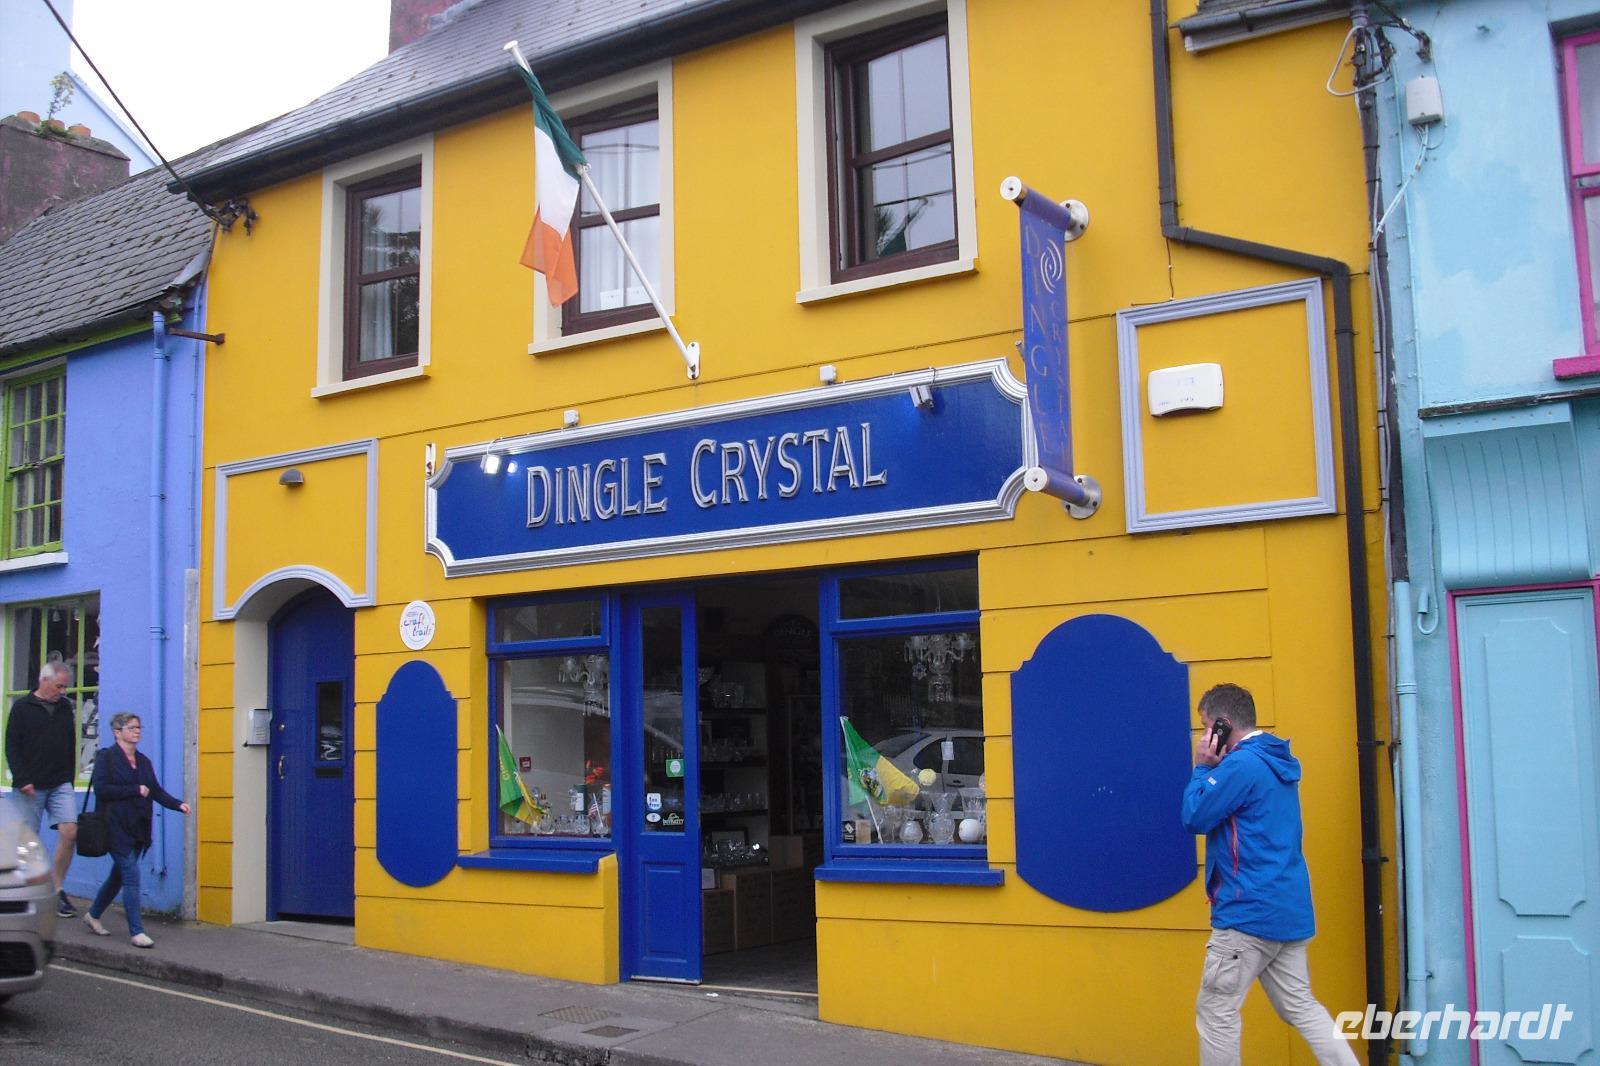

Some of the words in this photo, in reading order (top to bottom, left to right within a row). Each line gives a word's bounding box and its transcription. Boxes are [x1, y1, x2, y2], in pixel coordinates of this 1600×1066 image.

[1025, 223, 1050, 452] DINGLE
[526, 452, 668, 528] DINGLE
[691, 422, 888, 508] CRYSTAL
